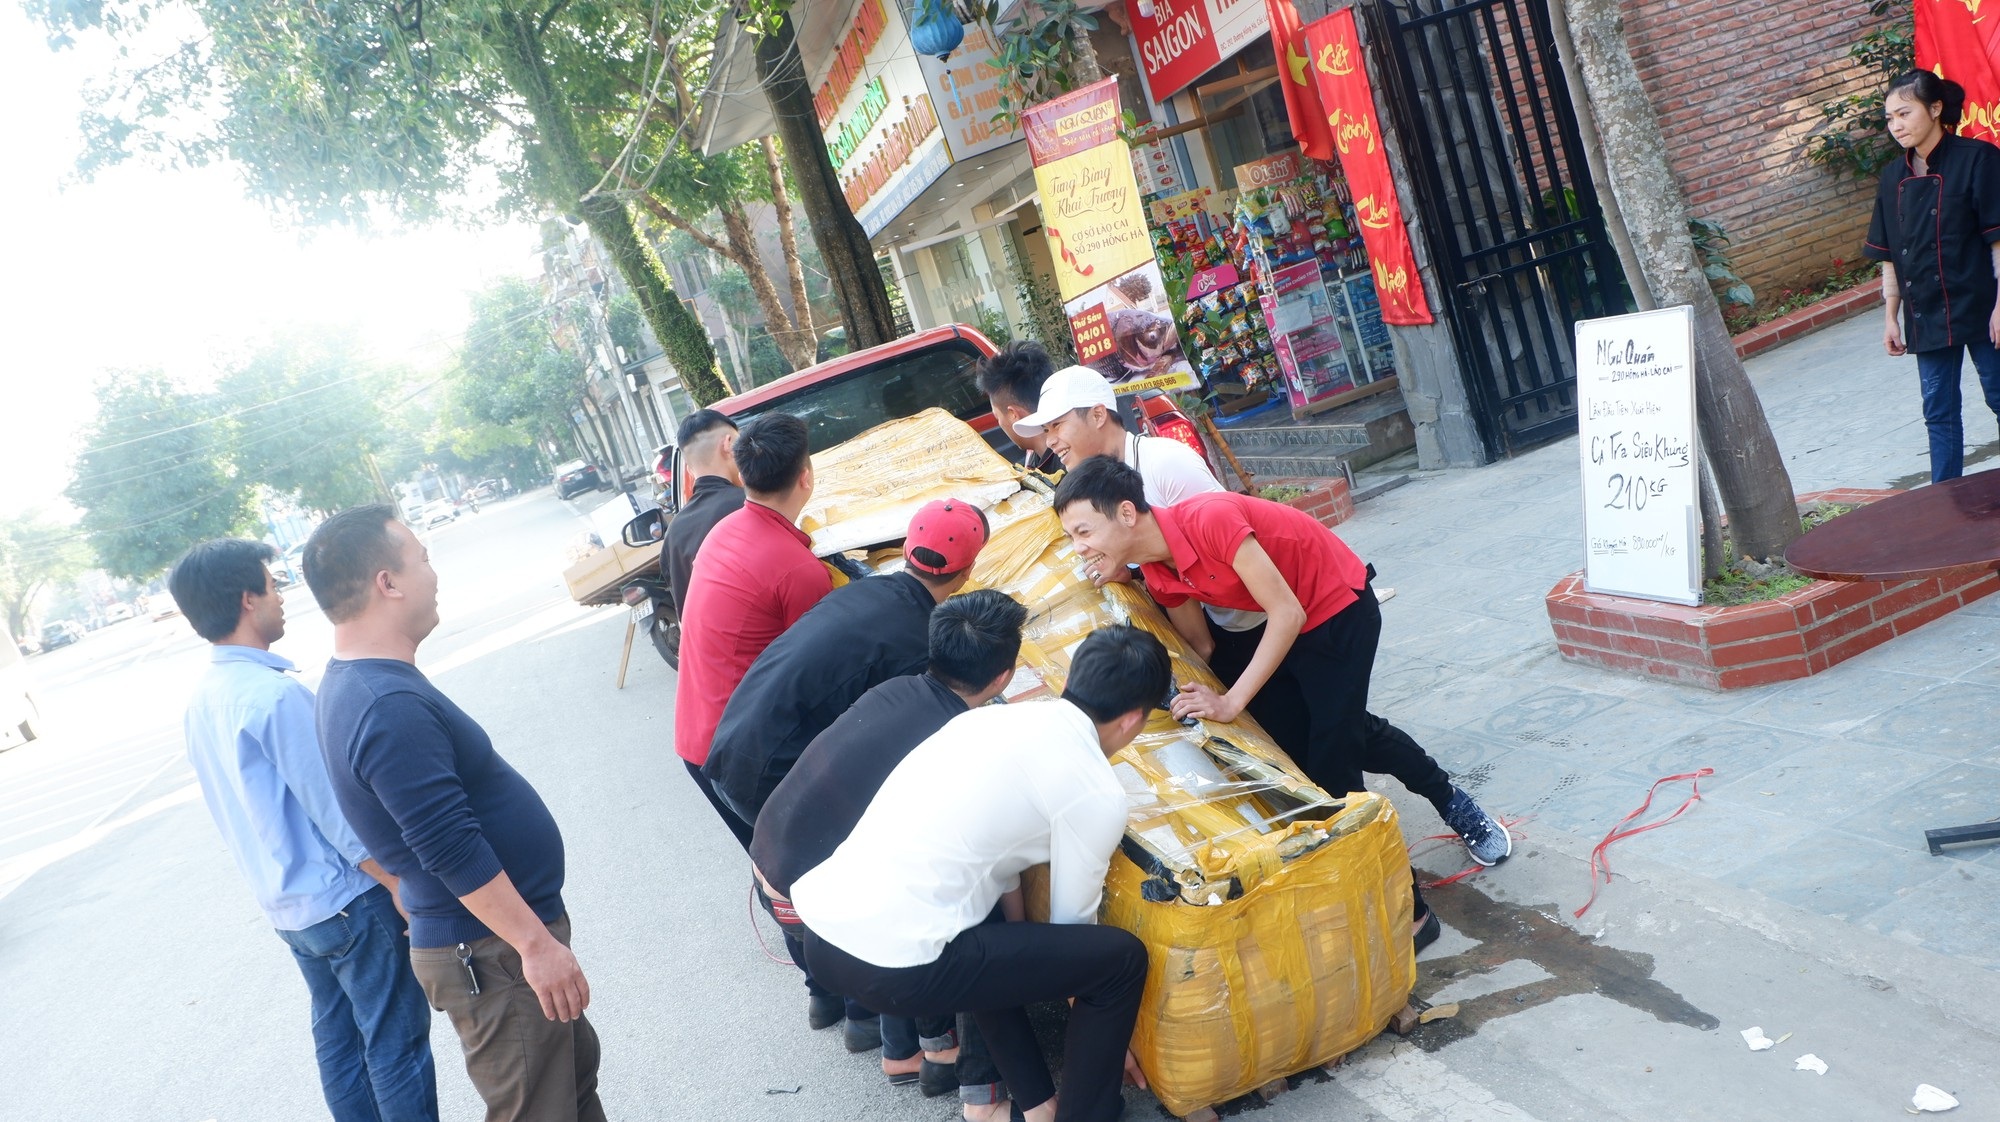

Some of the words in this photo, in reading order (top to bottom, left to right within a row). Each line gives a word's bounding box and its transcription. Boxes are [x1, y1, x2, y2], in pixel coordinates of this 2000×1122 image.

[1154, 0, 1174, 27] BIA
[1143, 5, 1203, 75] SAIGON
[1249, 159, 1289, 185] Oishi
[1052, 196, 1090, 218] Khai
[1113, 218, 1129, 231] CAI
[1087, 242, 1101, 252] 290
[1086, 311, 1102, 324] Sáu
[1077, 323, 1106, 344] 04/01
[1082, 337, 1112, 359] 2018
[1164, 376, 1177, 386] 966
[1611, 370, 1624, 383] 290
[1603, 473, 1648, 511] 210
[1649, 477, 1668, 495] KG
